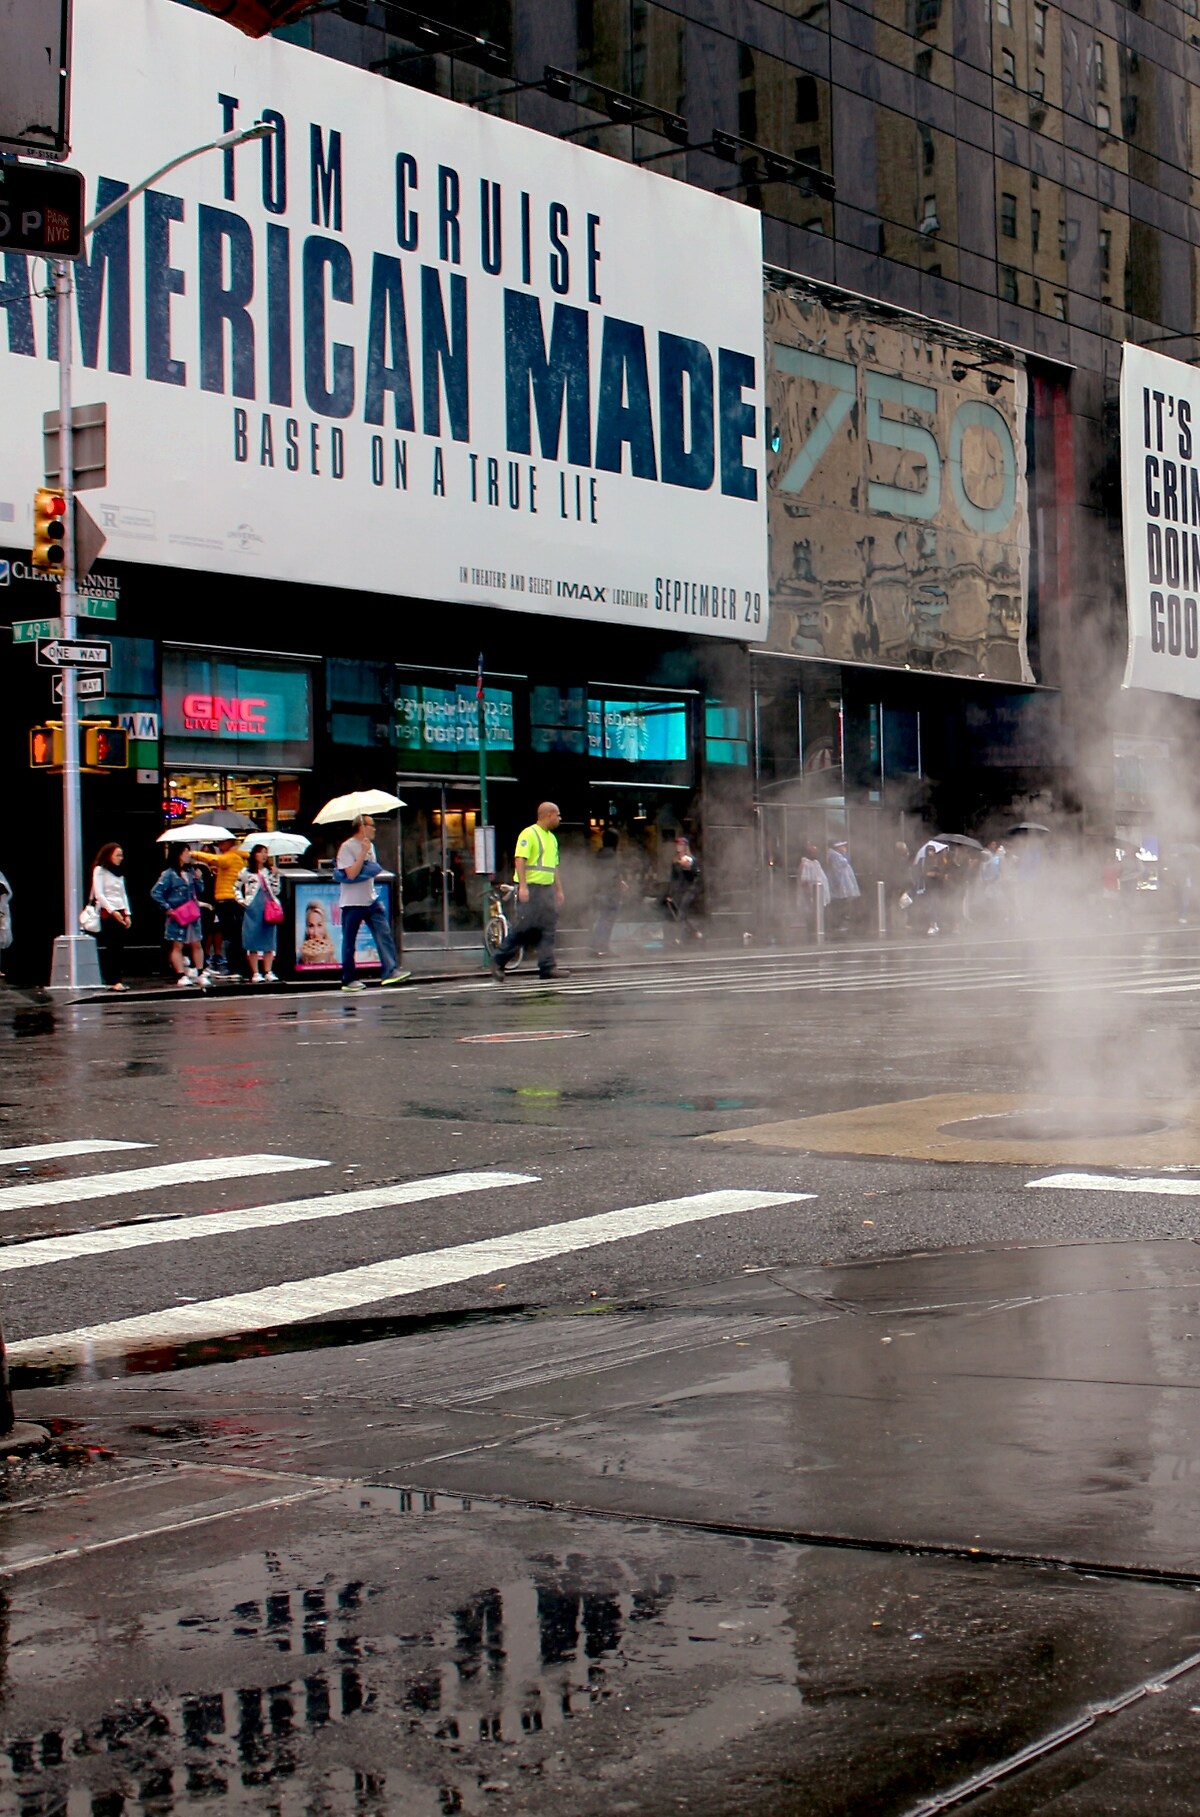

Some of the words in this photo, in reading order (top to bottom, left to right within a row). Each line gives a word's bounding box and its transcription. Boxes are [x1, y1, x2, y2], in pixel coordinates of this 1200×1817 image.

[218, 92, 343, 232] TOM
[396, 152, 601, 305] CRUISE
[47, 210, 69, 226] PARK
[47, 227, 70, 242] NYC
[504, 287, 759, 502] MADE
[1143, 387, 1192, 461] IT'S
[774, 341, 1018, 534] 750
[234, 407, 344, 480] BASED
[372, 435, 408, 491] ON
[433, 446, 446, 498] A
[469, 453, 538, 514] TRUE
[560, 471, 598, 525] LIE
[102, 510, 118, 528] R
[460, 566, 468, 584] IN
[472, 568, 506, 589] THEATERS
[510, 574, 525, 592] AND
[529, 577, 552, 596] SELECT
[557, 580, 606, 603] IMAX
[613, 589, 648, 609] LOCATIONS
[655, 577, 736, 620] SEPTEMBER
[745, 591, 761, 624] 29
[90, 600, 98, 615] 7
[14, 626, 22, 640] W
[26, 623, 41, 638] 49
[43, 622, 50, 631] ST
[49, 648, 69, 659] ONE
[80, 650, 102, 660] WAY
[82, 680, 99, 692] WAY
[183, 693, 267, 723] GNC
[138, 715, 157, 737] M
[185, 718, 219, 731] LIVE
[225, 720, 266, 733] WELL
